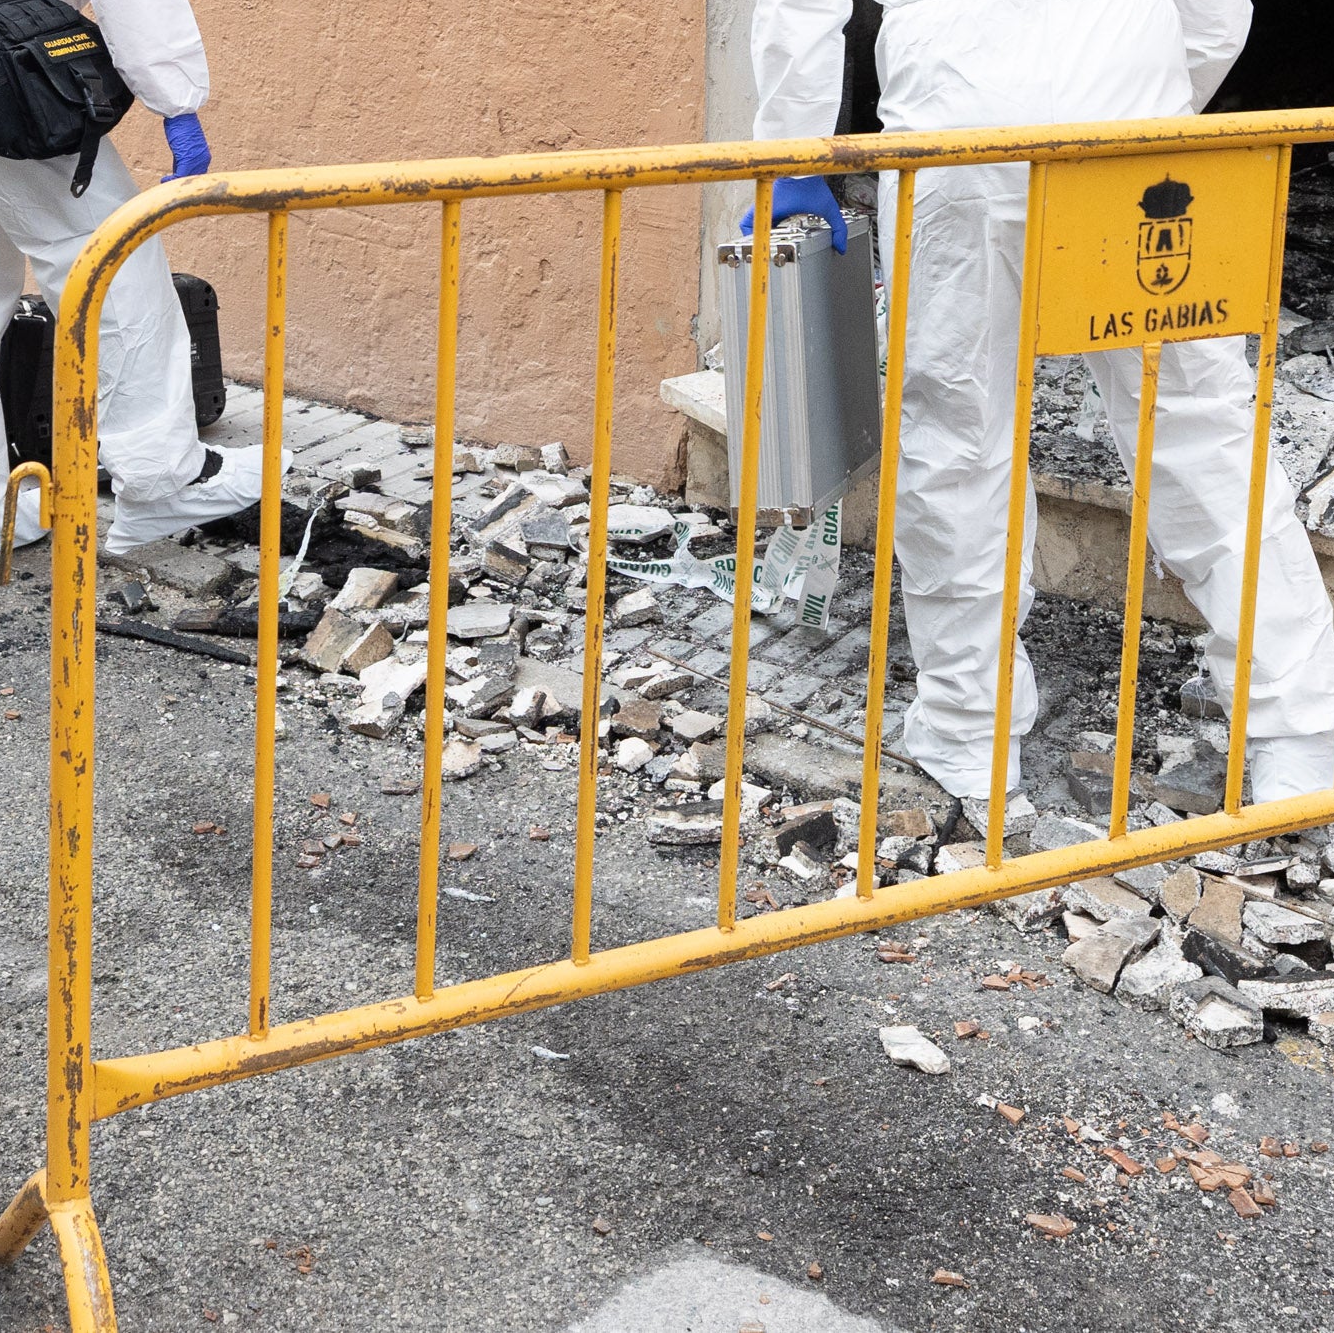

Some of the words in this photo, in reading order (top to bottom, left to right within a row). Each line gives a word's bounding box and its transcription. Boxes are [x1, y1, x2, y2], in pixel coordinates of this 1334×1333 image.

[44, 37, 74, 48] GUARDIA
[73, 33, 90, 42] CIVIL
[1089, 311, 1133, 341] LAS
[1144, 298, 1229, 333] GABIAS
[801, 593, 826, 626] CIVIL
